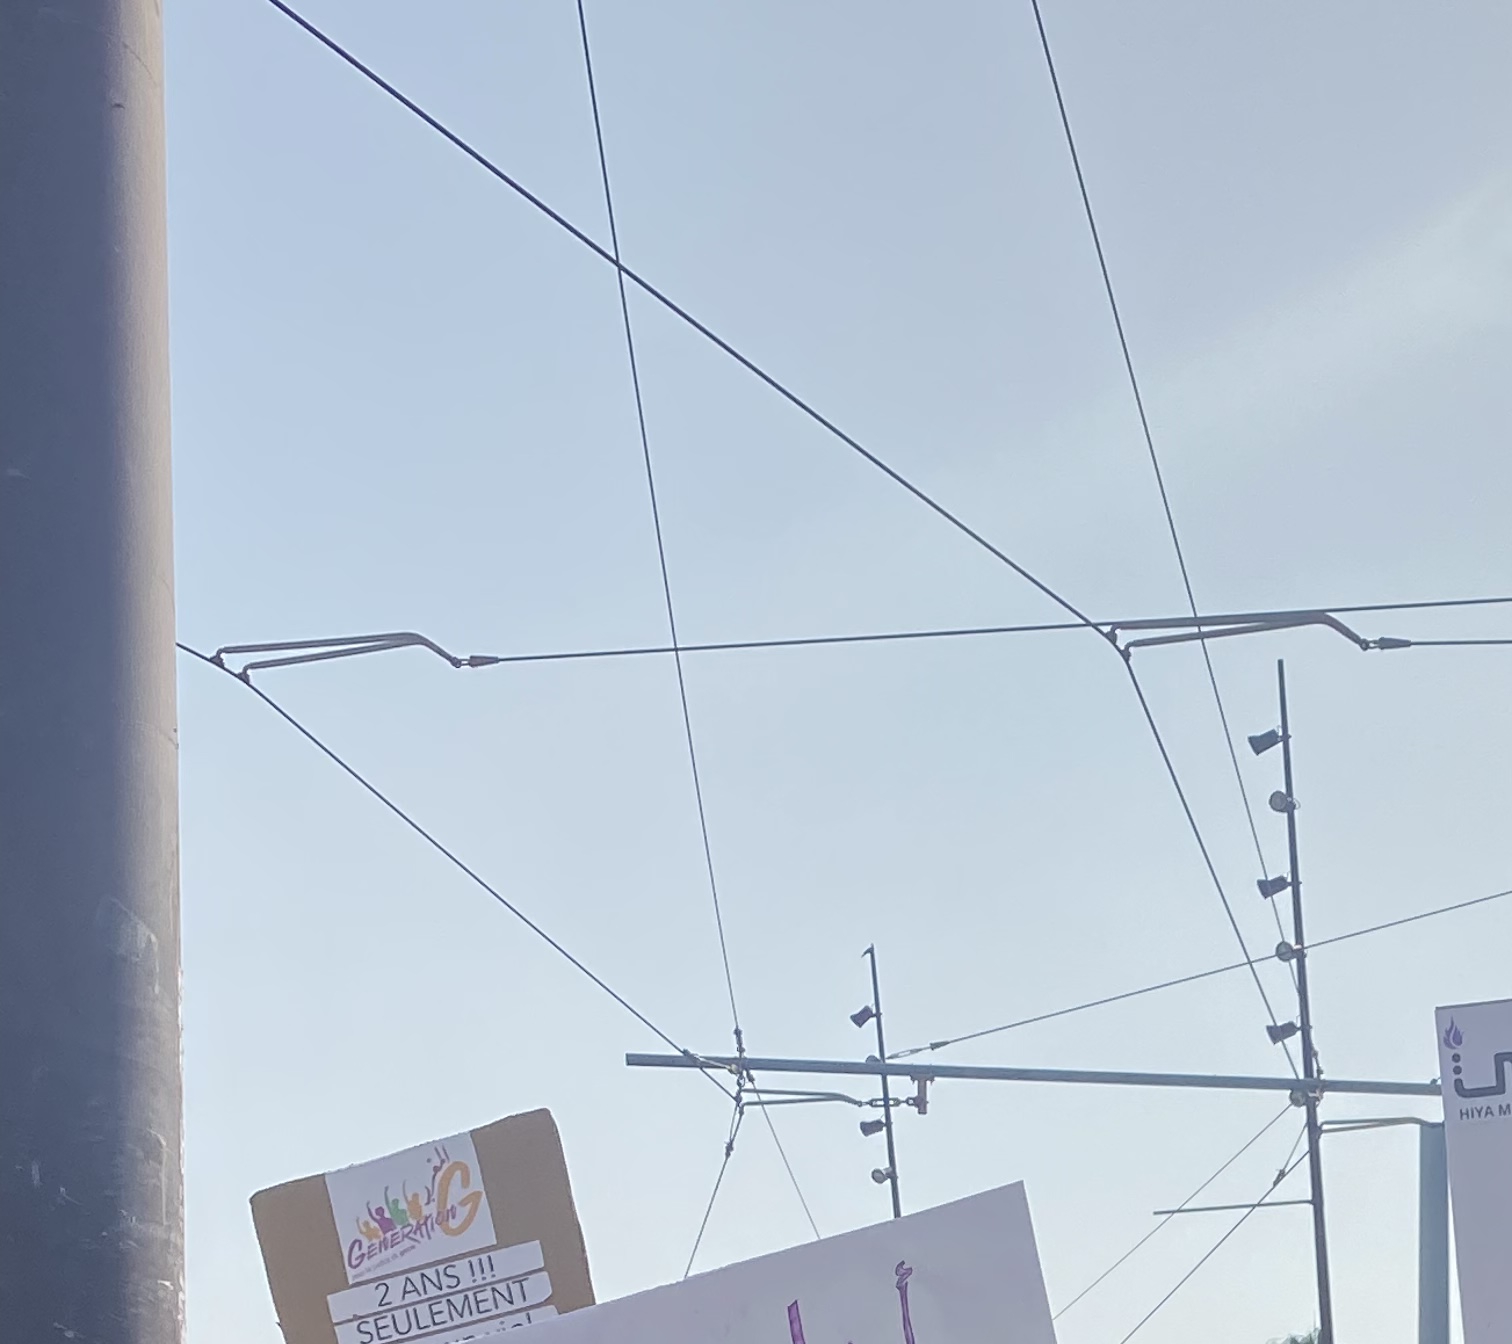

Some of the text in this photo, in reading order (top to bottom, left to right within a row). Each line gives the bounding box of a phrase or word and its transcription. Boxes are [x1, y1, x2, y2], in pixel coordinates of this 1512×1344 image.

[1459, 1105, 1495, 1121] HIYA
[374, 1254, 496, 1308] 2 ANS !!!
